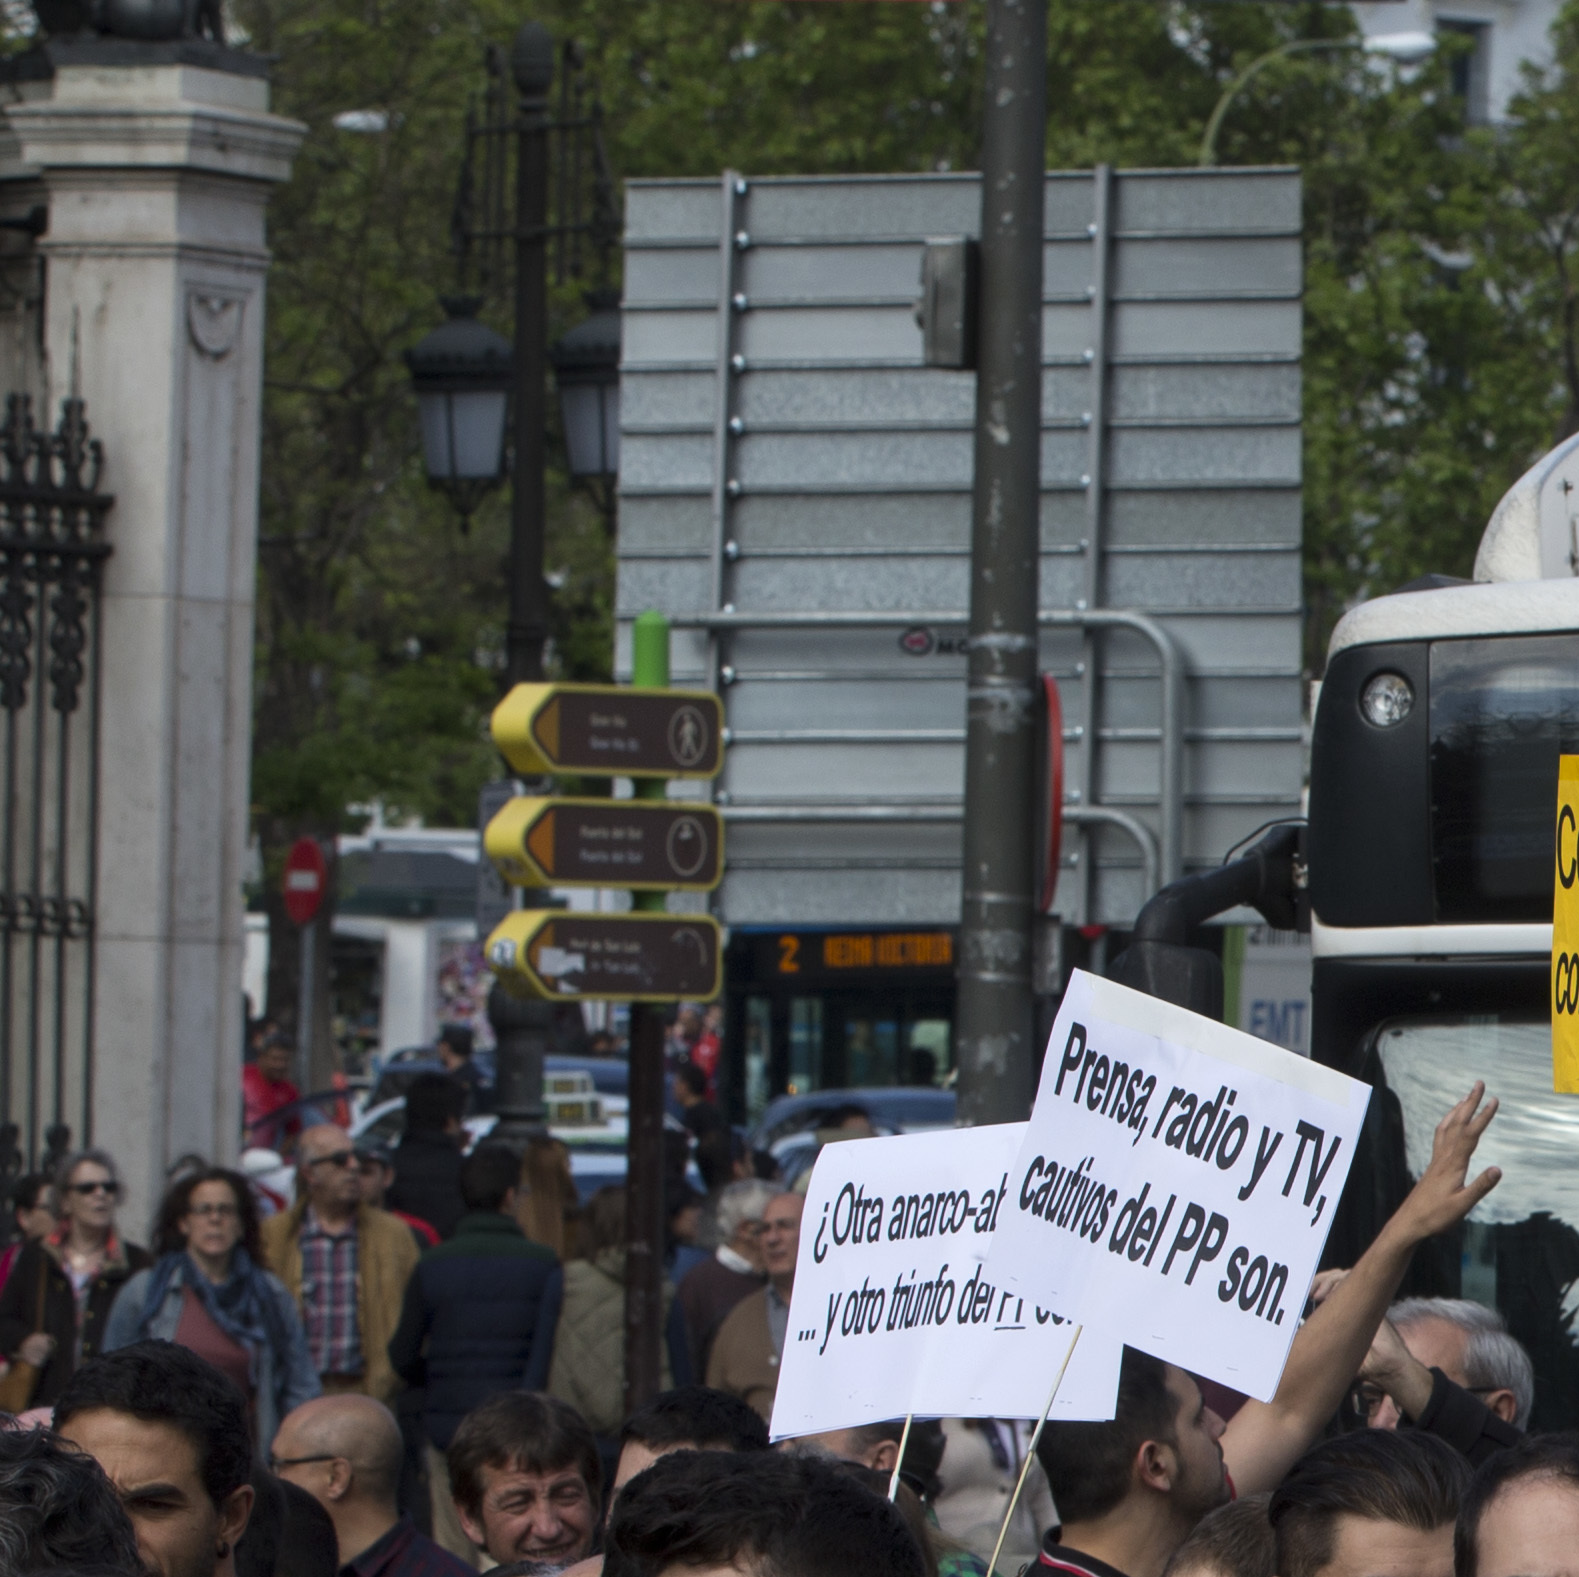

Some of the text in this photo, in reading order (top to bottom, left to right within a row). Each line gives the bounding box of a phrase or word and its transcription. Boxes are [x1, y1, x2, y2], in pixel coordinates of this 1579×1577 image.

[778, 935, 800, 974] 2
[1054, 1022, 1344, 1229] Prensa, radio y TV,
[813, 1181, 882, 1264] ¿Otra
[1018, 1154, 1287, 1327] cautivos del PP son.
[820, 1290, 838, 1355] y
[841, 1276, 885, 1336] otro
[886, 1262, 954, 1333] triunfo
